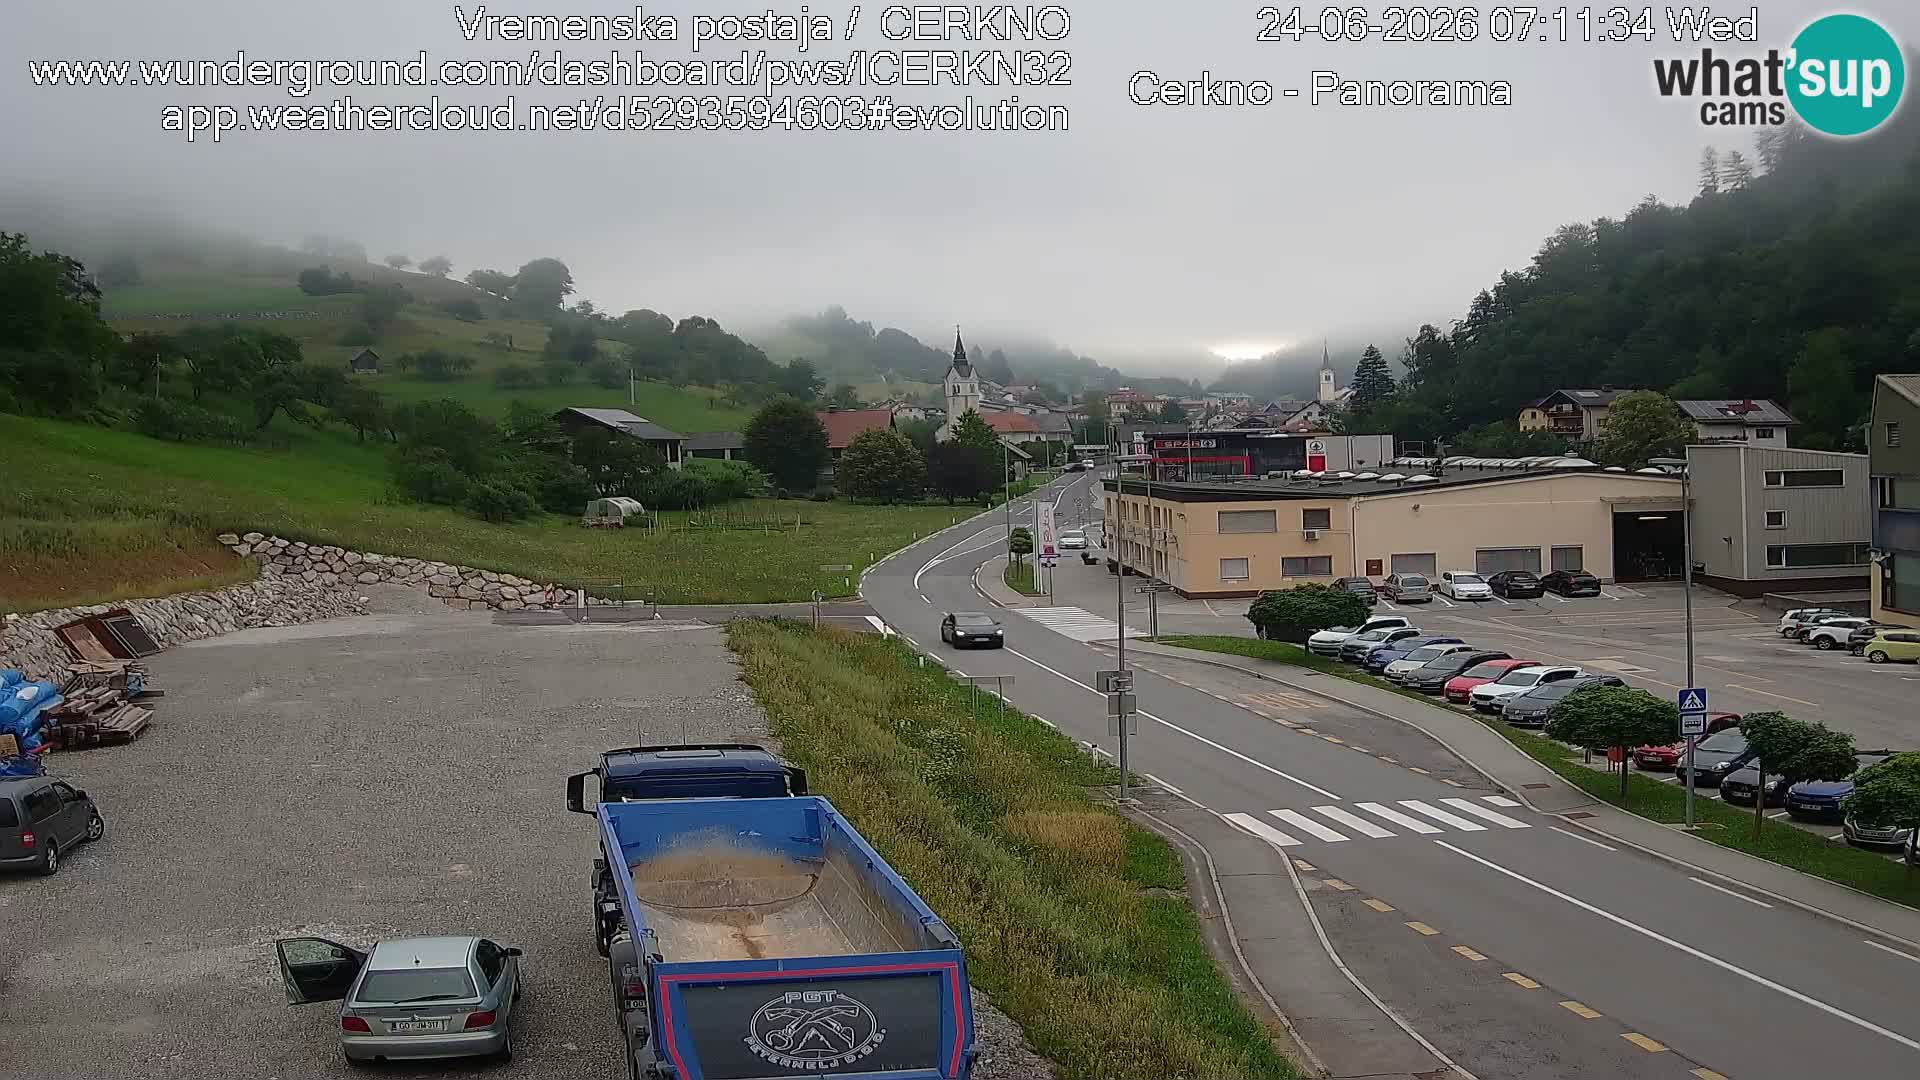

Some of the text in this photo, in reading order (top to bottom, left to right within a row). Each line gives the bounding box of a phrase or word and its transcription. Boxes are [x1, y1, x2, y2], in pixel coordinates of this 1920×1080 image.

[1164, 441, 1200, 449] SPAR
[785, 989, 837, 1004] PGT
[743, 1036, 840, 1070] PETERNELJ
